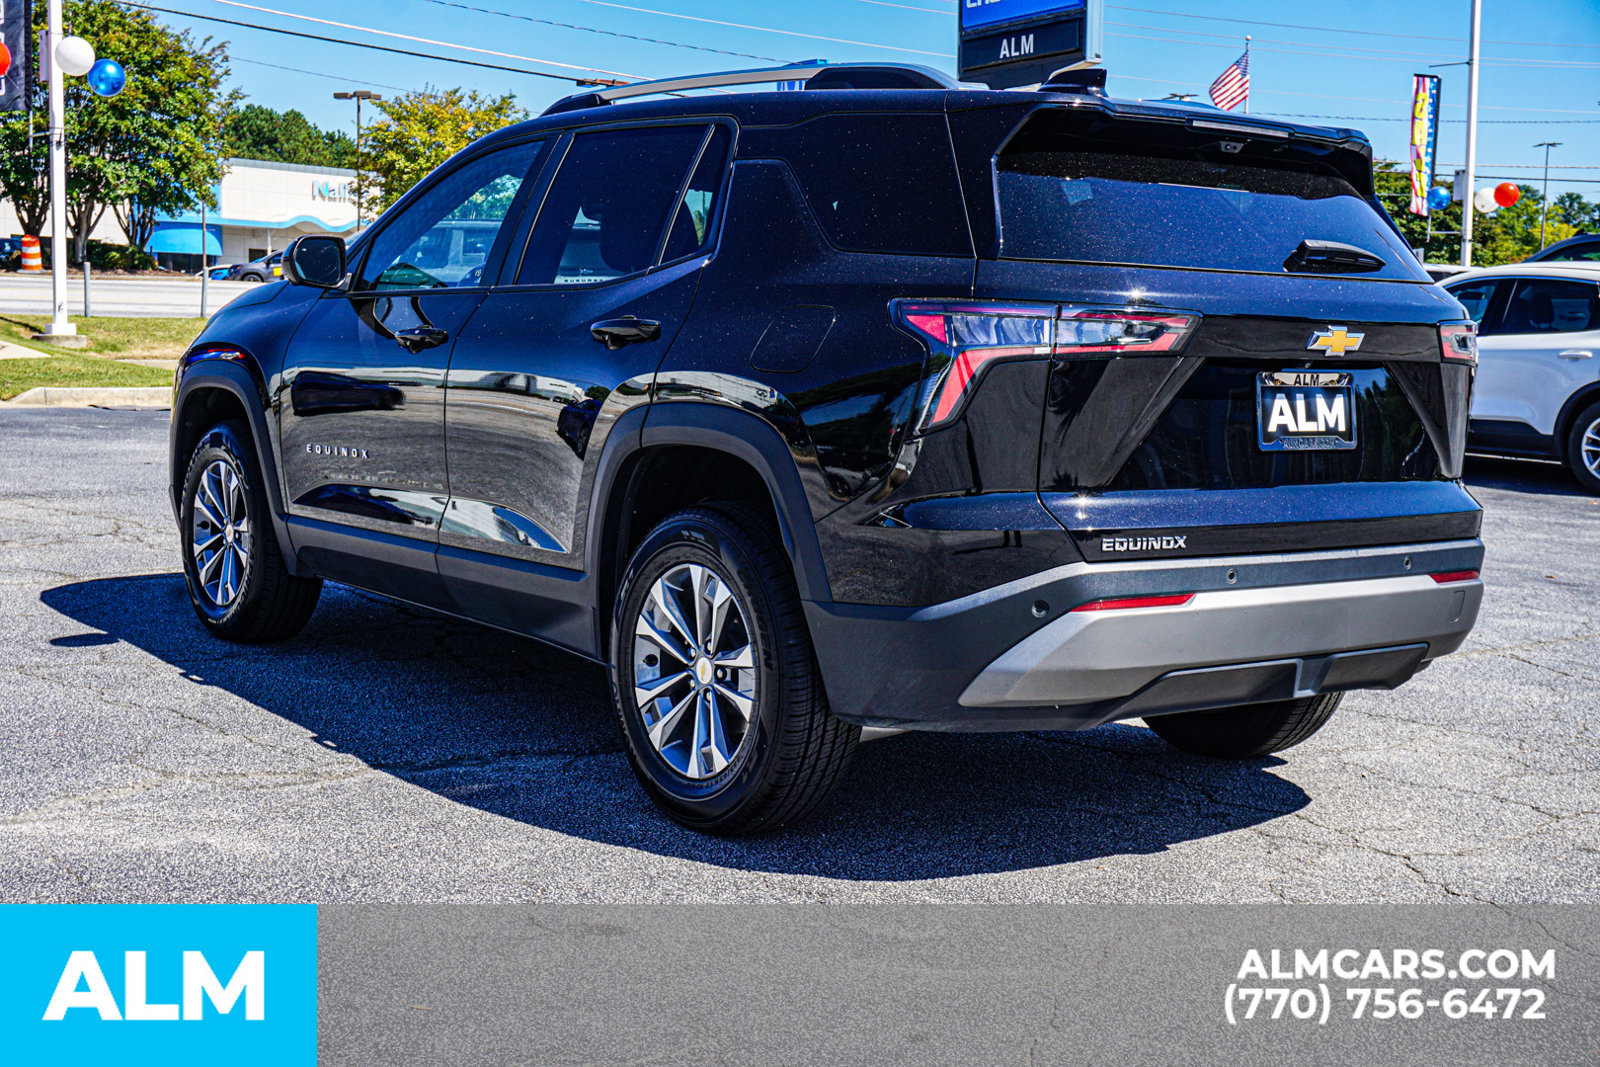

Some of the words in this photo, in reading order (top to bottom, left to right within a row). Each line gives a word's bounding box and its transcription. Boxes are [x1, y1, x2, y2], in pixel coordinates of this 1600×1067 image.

[999, 33, 1034, 59] ALM
[1294, 374, 1320, 386] ALM
[1267, 393, 1346, 432] ALM
[306, 443, 369, 459] EQUINOX
[1102, 535, 1187, 552] EQUINOX
